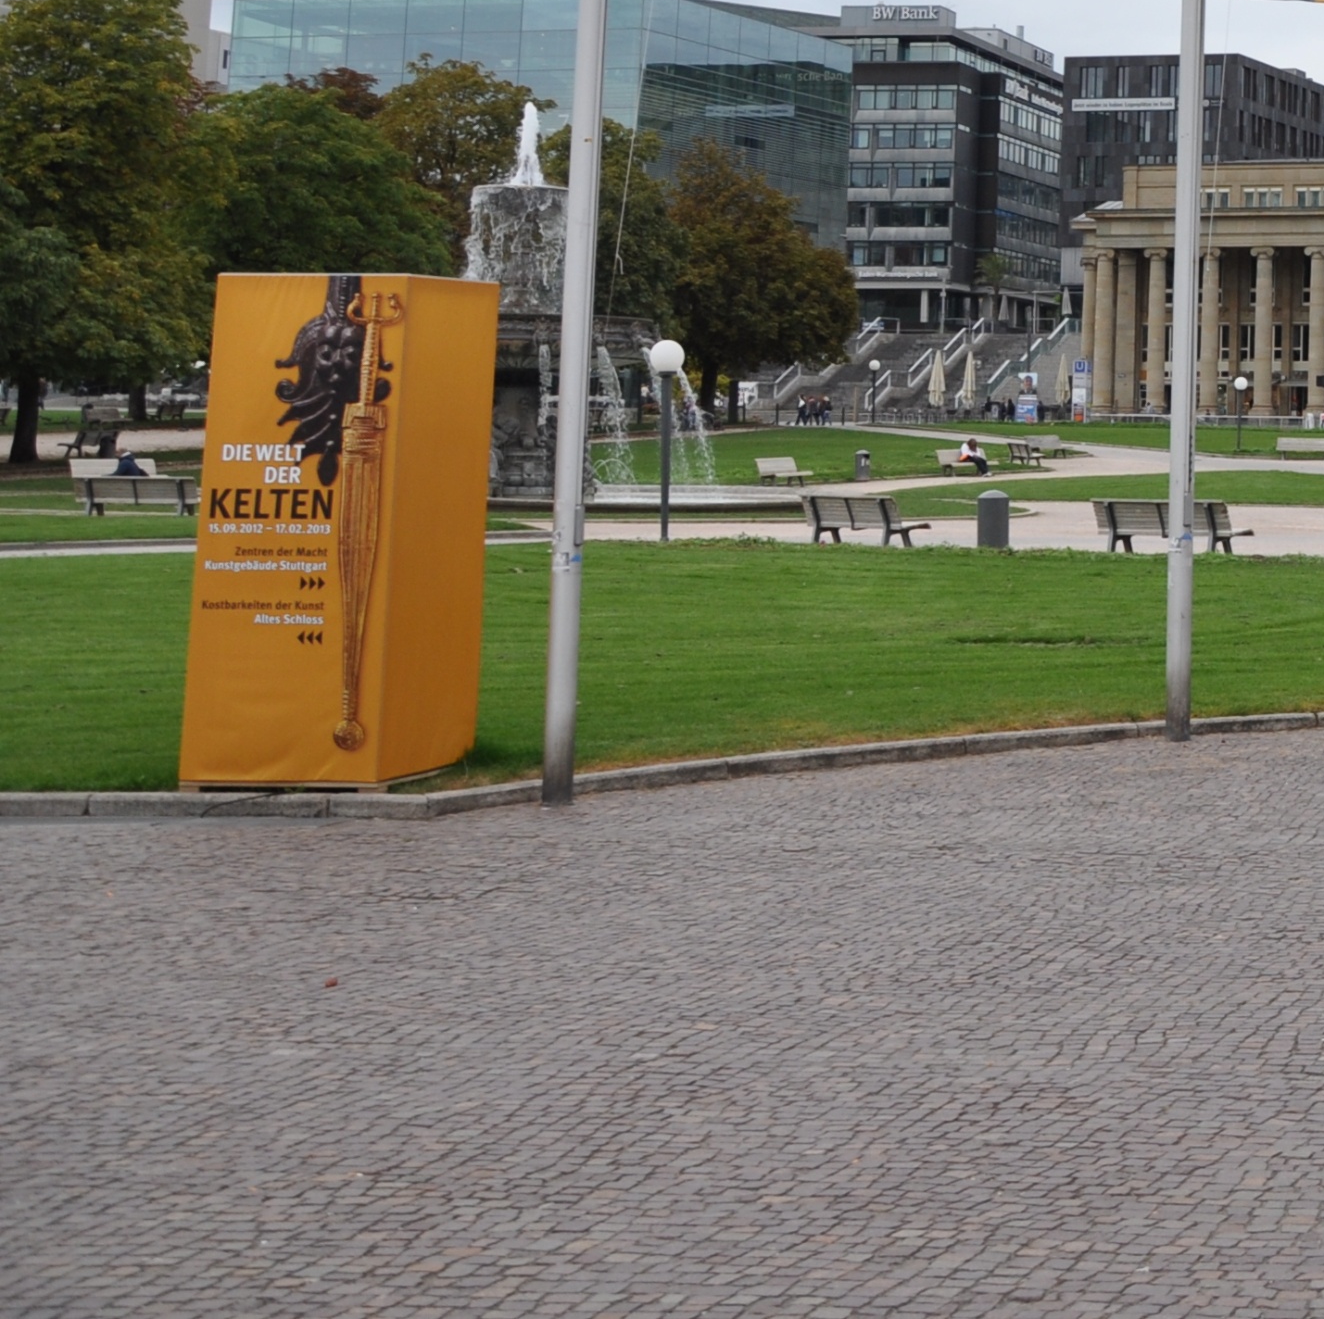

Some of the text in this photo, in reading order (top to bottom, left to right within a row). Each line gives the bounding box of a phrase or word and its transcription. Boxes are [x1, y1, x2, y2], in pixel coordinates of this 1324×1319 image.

[871, 5, 938, 20] BW Bank
[222, 444, 306, 462] DIE WELT
[264, 466, 301, 484] DER
[209, 488, 334, 520] KELTEN
[234, 546, 328, 557] Zentren der Macht
[204, 560, 327, 573] Kunstgebäude Stuttgart
[201, 600, 325, 610] Kostbarkeiten der Kunst
[254, 614, 324, 625] Altes Schloss
